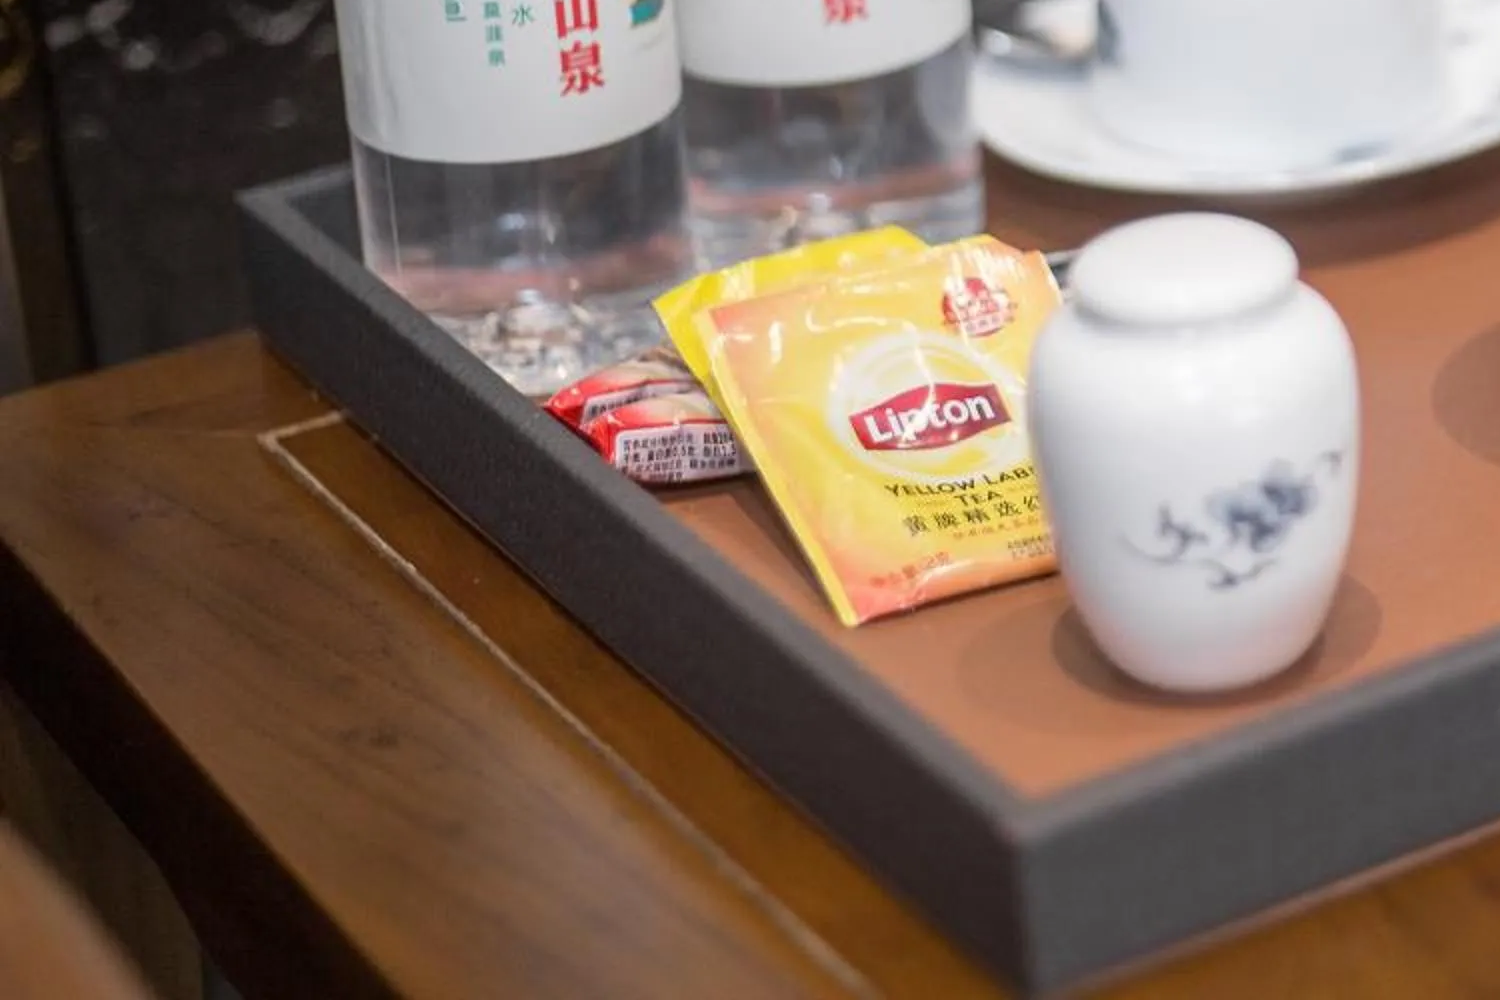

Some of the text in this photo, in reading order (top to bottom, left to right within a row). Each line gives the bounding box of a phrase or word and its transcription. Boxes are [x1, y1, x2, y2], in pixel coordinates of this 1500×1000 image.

[864, 395, 996, 443] Lipton
[884, 465, 1035, 497] YELLOW LAB
[954, 490, 1004, 507] TEA
